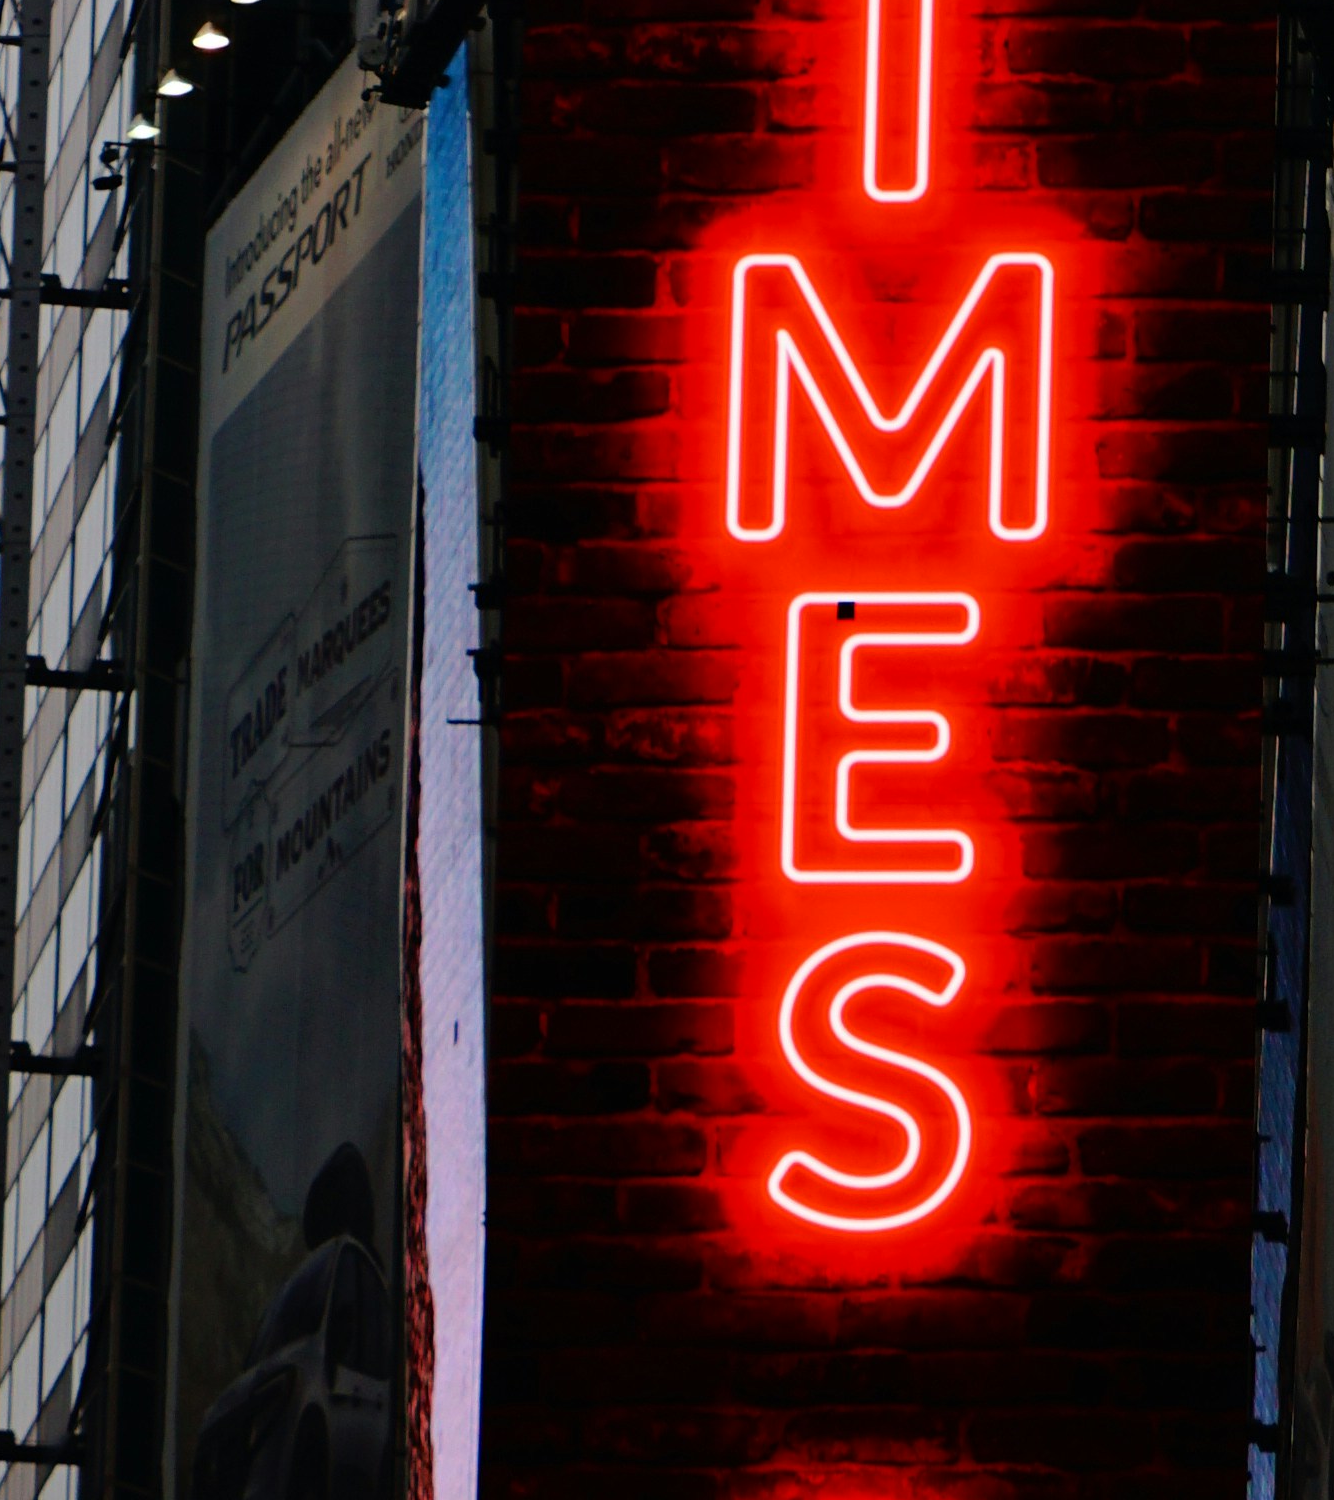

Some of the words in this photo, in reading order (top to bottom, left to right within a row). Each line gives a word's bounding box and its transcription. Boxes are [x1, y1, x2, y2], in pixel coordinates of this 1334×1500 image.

[222, 152, 372, 375] PASSPORT
[225, 186, 297, 298] Introducing
[302, 152, 322, 205] the
[230, 665, 288, 780] TRADE
[297, 579, 392, 698] MARQUEES
[232, 843, 265, 914] FOR
[275, 728, 392, 883] MOUNTAINS
